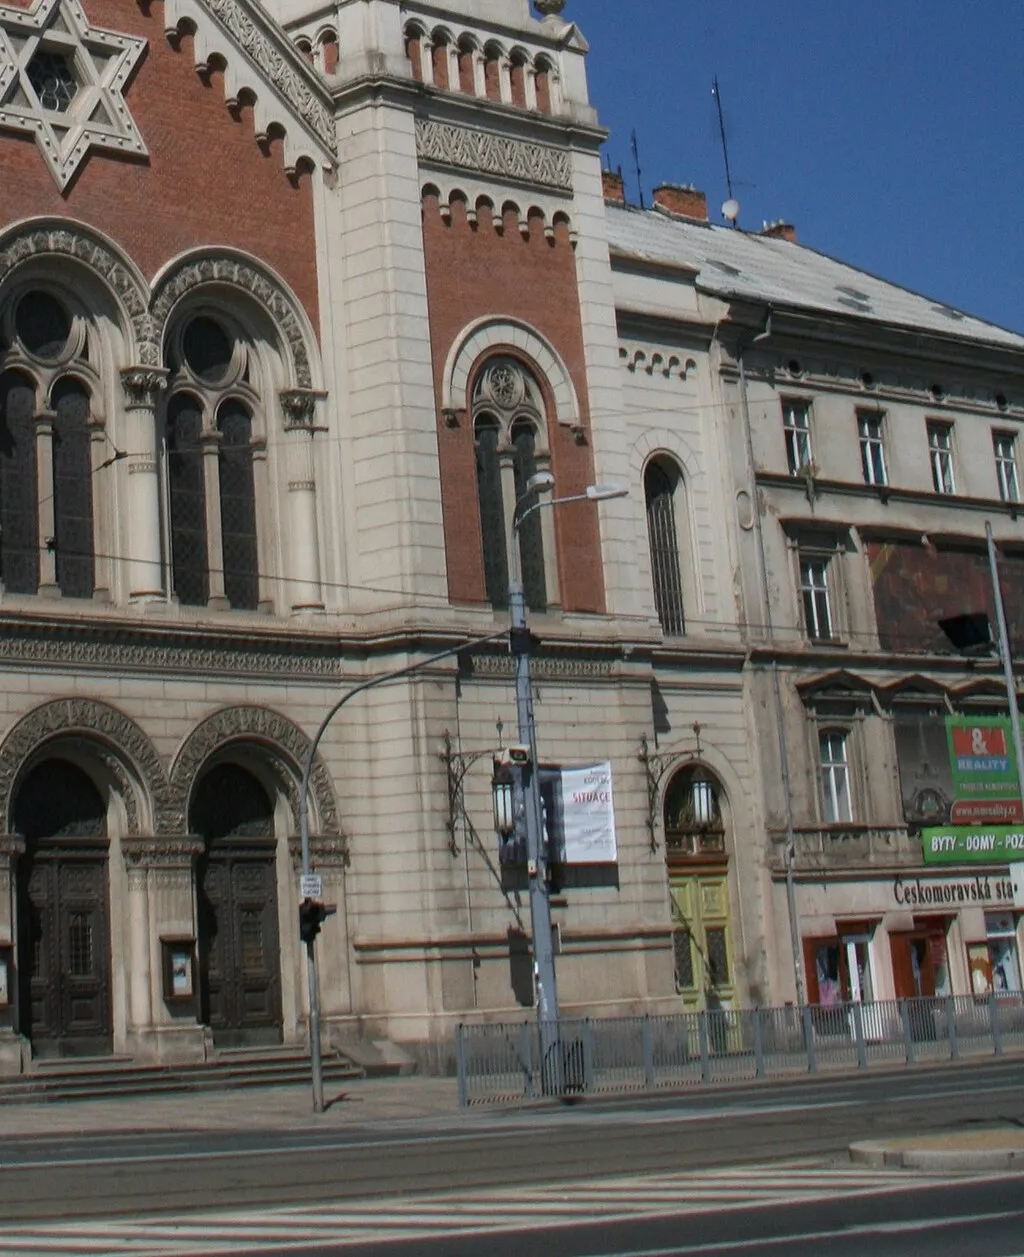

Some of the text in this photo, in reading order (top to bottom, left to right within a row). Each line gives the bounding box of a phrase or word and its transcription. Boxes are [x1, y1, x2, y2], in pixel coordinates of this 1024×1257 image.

[957, 758, 1008, 771] REALITY
[932, 836, 956, 851] BYTY
[967, 835, 996, 850] DOMY
[894, 875, 992, 904] Českomoravská
